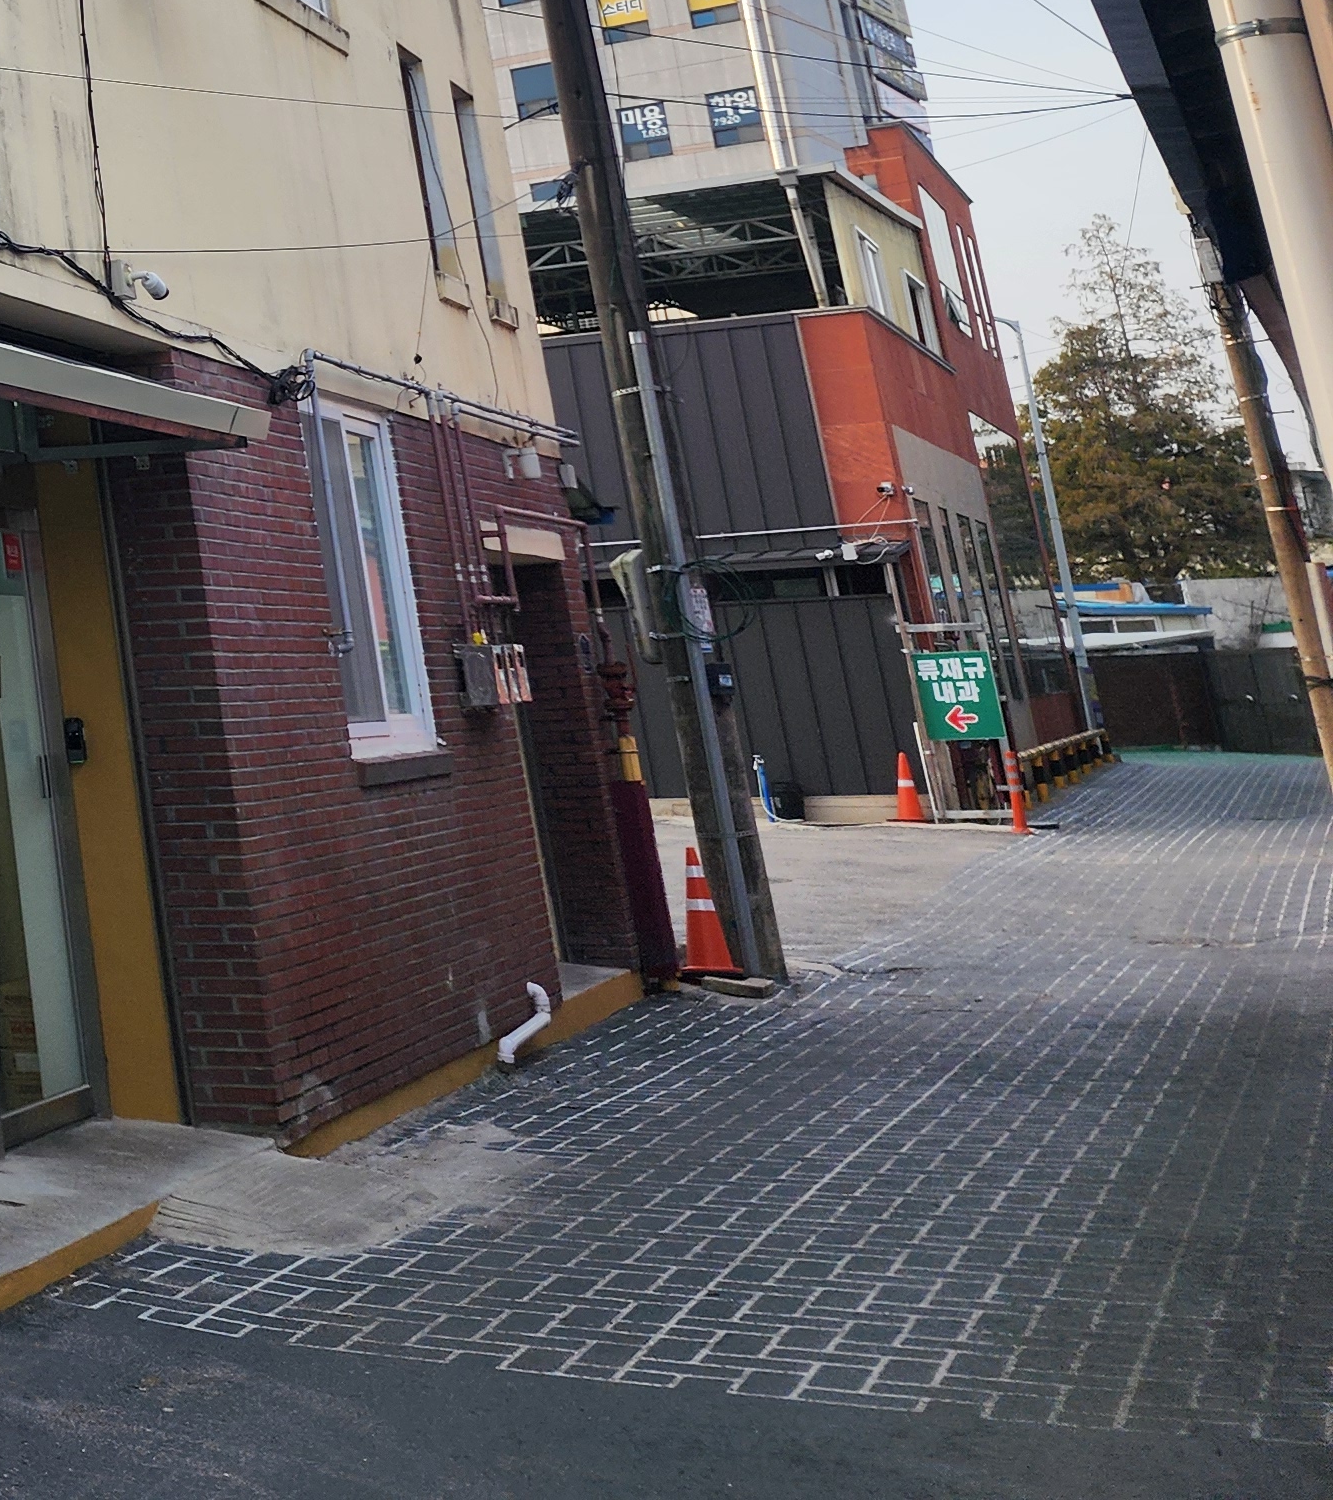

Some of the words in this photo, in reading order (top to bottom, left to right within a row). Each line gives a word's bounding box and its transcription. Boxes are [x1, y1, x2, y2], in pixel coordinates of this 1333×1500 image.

[620, 104, 665, 130] 미용
[708, 90, 757, 116] 학원
[917, 657, 987, 681] 류재규
[932, 680, 980, 703] 내과
